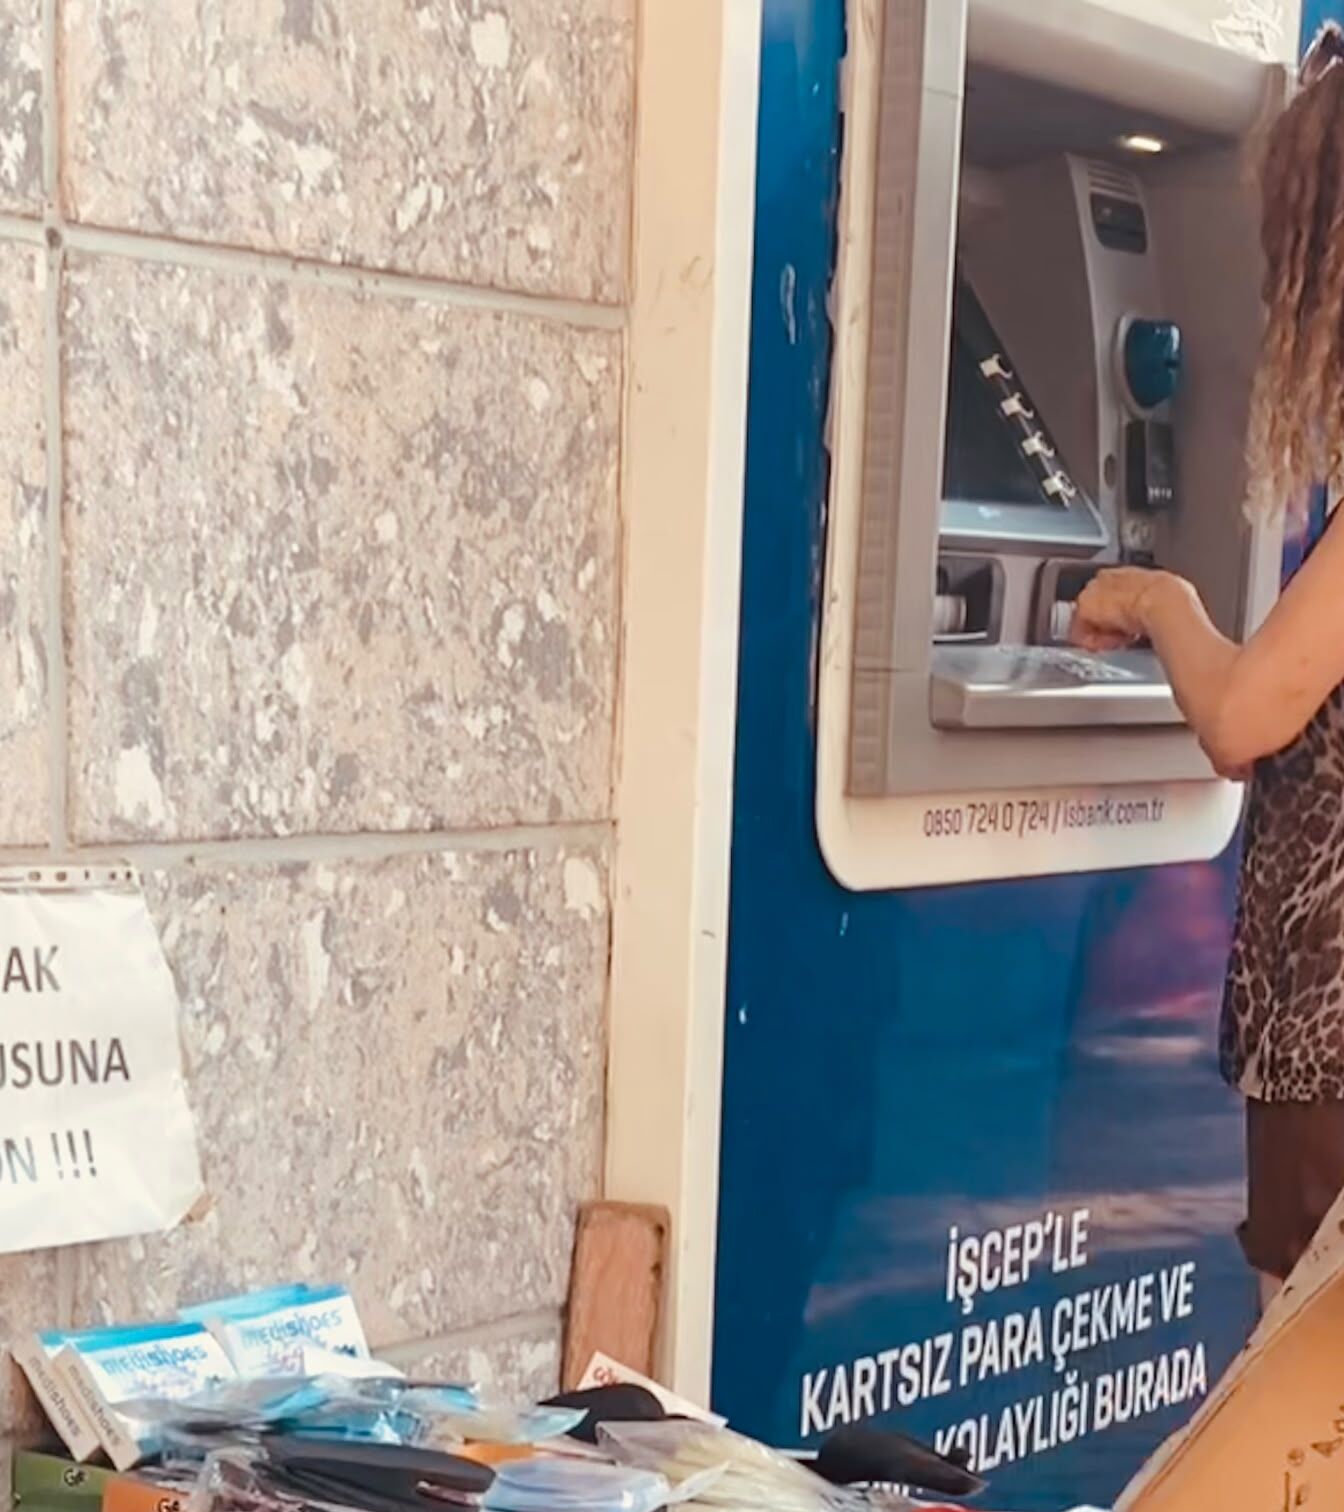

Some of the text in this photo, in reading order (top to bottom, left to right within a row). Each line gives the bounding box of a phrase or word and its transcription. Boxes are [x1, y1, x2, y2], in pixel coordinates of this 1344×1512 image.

[923, 809, 962, 837] 0850
[967, 803, 998, 833] 724
[1002, 801, 1013, 832] 0
[1018, 800, 1049, 837] 724
[51, 1129, 97, 1179] !!!
[946, 1208, 1090, 1315] İŞCEP'LE
[799, 1262, 1196, 1437] KARTSIZ PARA ÇEKME VE
[934, 1342, 1208, 1474] KOLAYLIĞI BURADA
